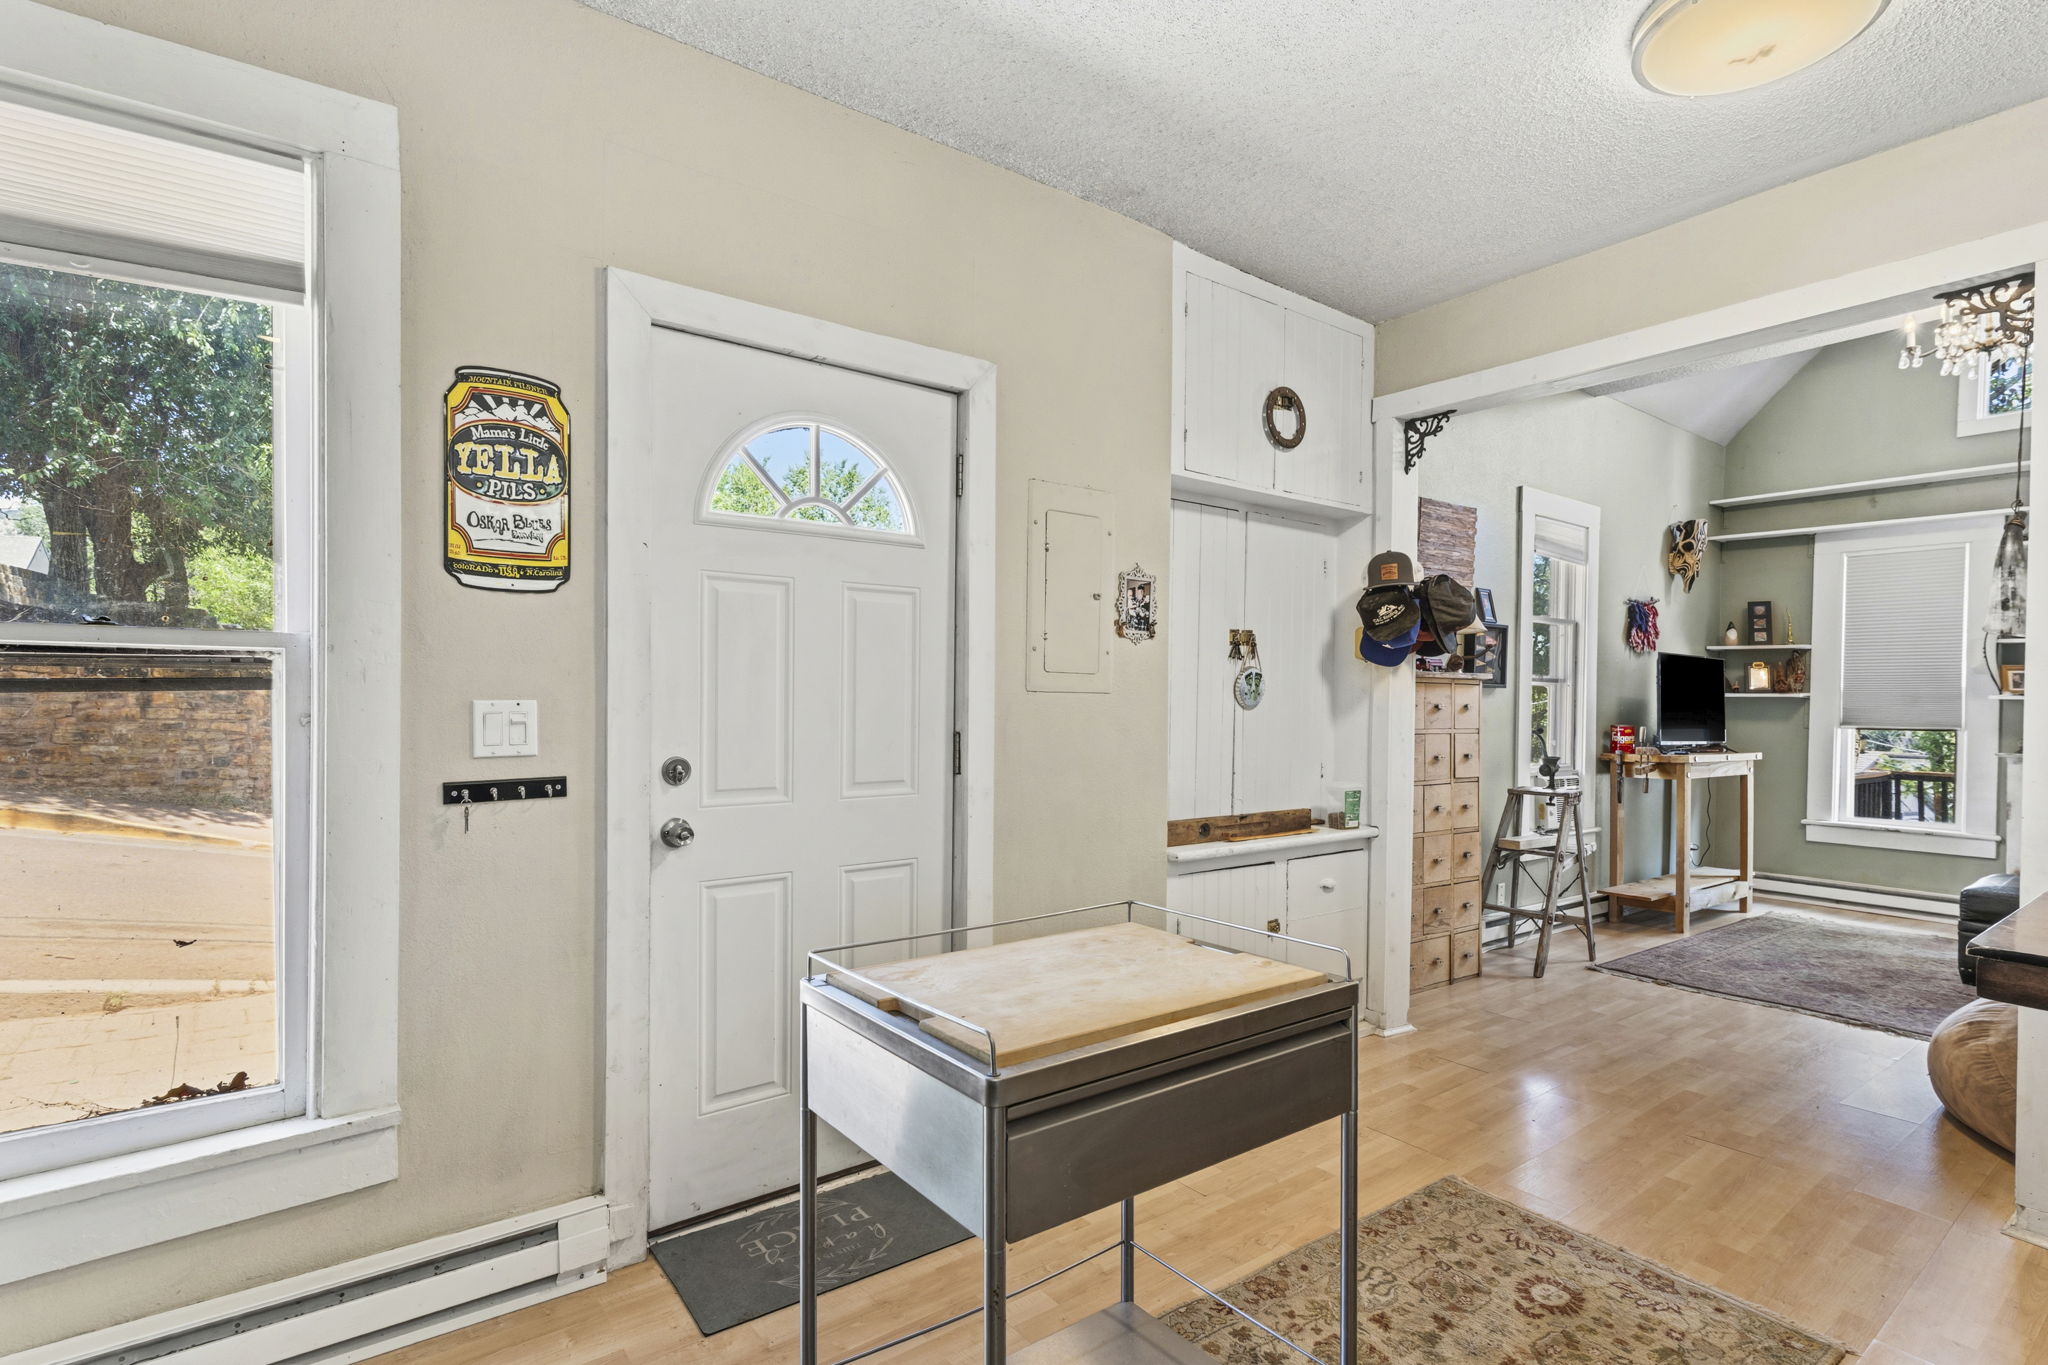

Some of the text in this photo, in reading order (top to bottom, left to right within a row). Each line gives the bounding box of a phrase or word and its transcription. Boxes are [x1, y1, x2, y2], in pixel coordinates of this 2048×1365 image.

[468, 375, 513, 387] MOUNTAIN
[470, 424, 549, 451] Mama's Little
[454, 441, 562, 485] YELLA
[487, 479, 536, 500] PILS
[499, 565, 520, 578] USA
[740, 1206, 872, 1257] PLCE
[759, 1223, 886, 1265] hapy
